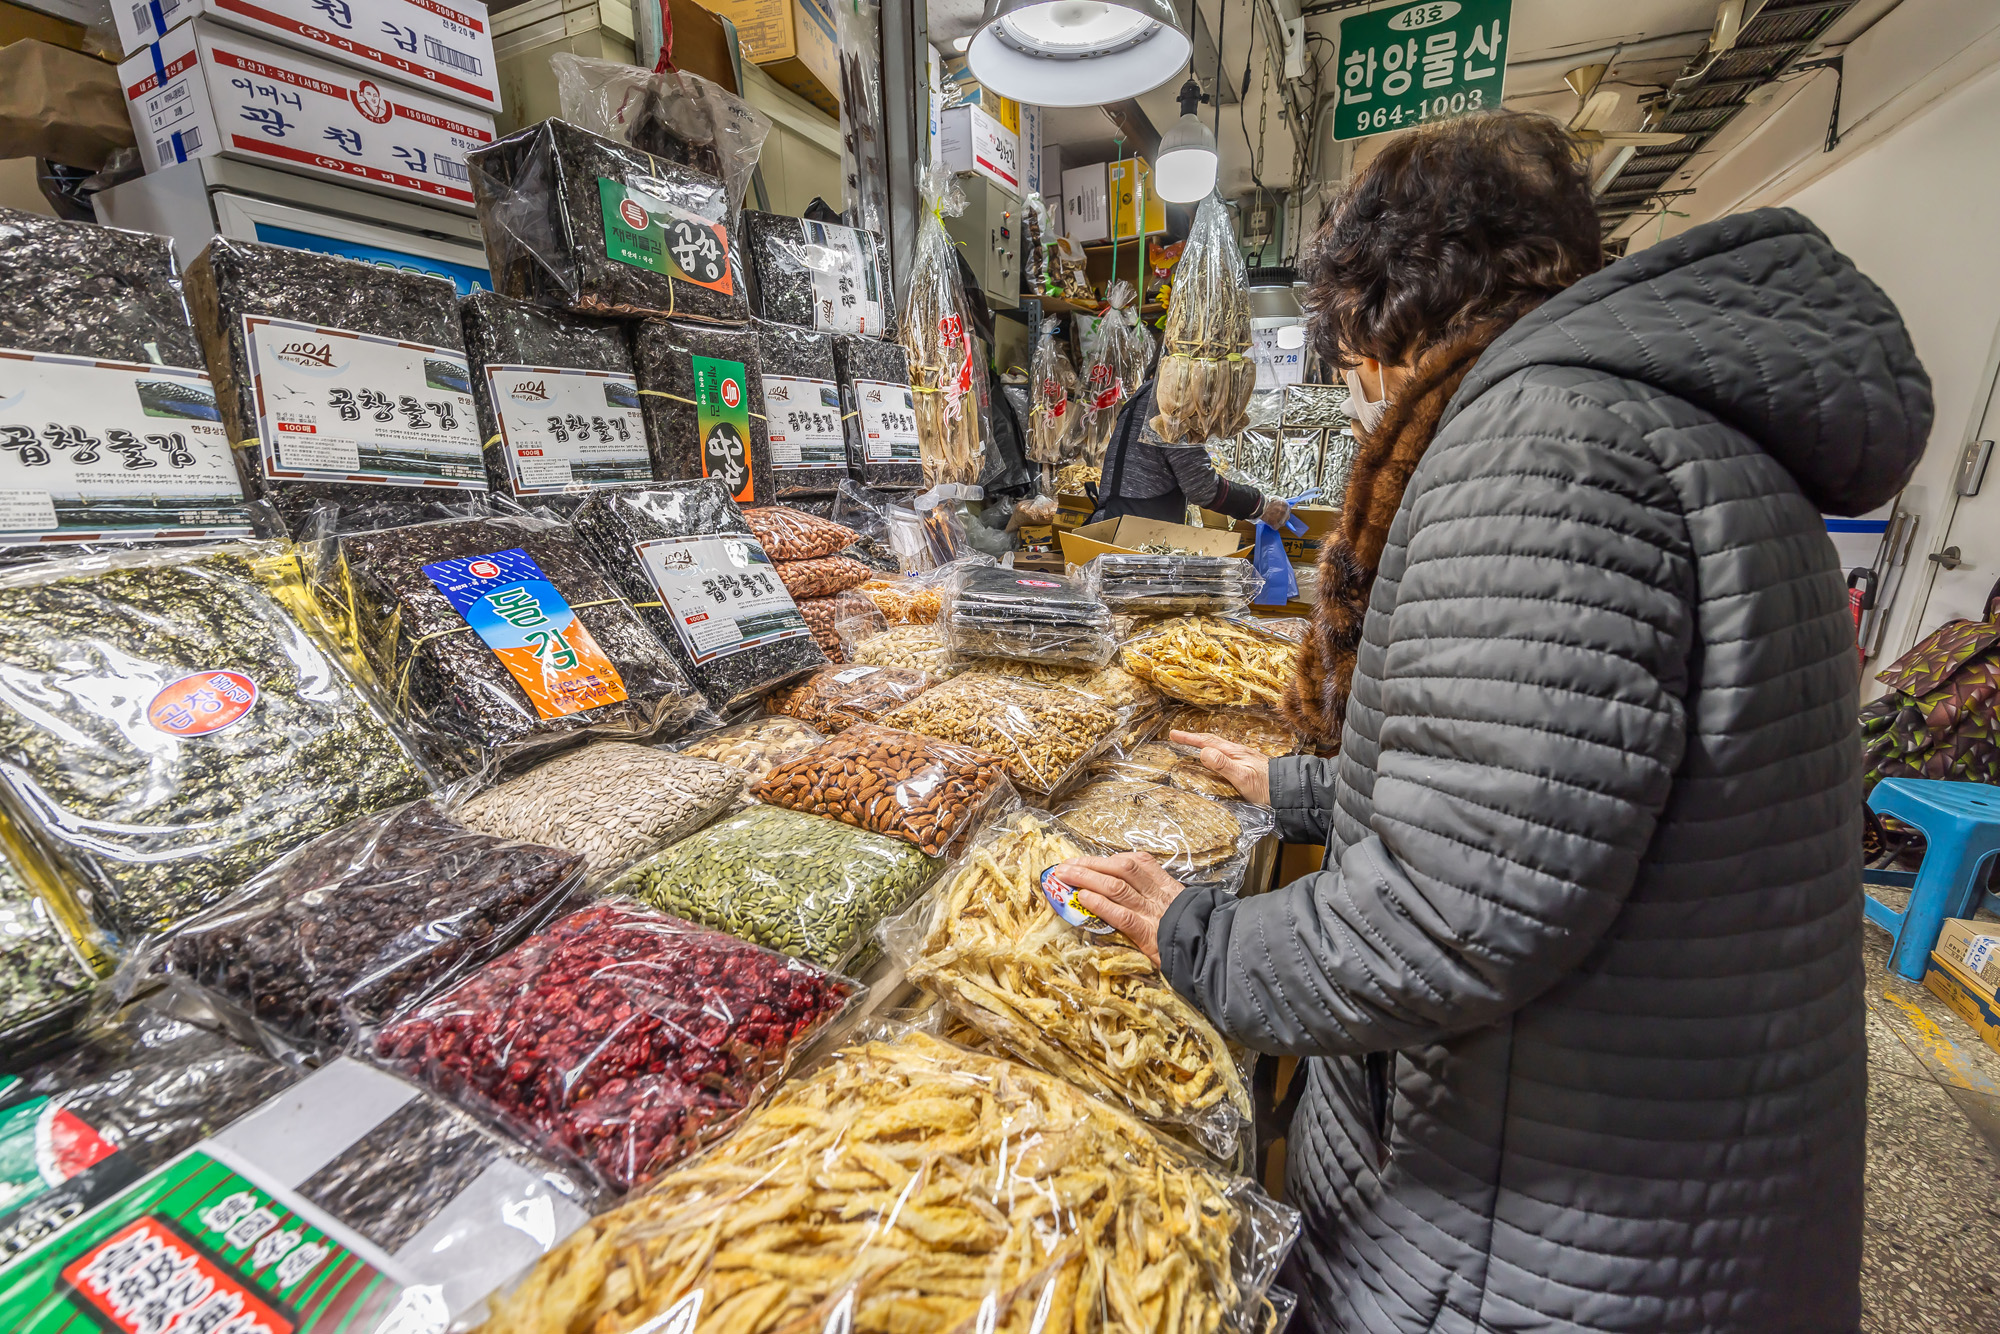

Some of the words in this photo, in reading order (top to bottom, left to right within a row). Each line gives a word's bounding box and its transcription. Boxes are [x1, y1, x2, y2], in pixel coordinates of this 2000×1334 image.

[435, 4, 455, 19] 2008
[1402, 4, 1444, 28] 43호
[236, 57, 267, 74] 원산지
[276, 70, 295, 84] 국산
[1343, 19, 1503, 106] 한양물산
[231, 77, 303, 111] 어머니
[1357, 88, 1484, 132] 964-1003
[446, 121, 465, 133] 2008
[626, 203, 645, 226] 특
[671, 222, 721, 280] 곱창
[280, 342, 332, 364] 1004
[1274, 355, 1284, 363] 27
[512, 380, 547, 397] 1004
[723, 382, 738, 404] 특
[328, 387, 459, 430] 곱창돌김
[284, 424, 311, 433] 100매
[547, 413, 631, 443] 곱창돌김
[788, 410, 834, 433] 곱창돌김
[881, 411, 915, 432] 곱창돌김
[0, 421, 197, 470] 곱창돌김
[472, 562, 495, 576] 특
[702, 572, 775, 604] 곱창돌김
[555, 694, 575, 707] DRY
[580, 686, 608, 701] LAVER
